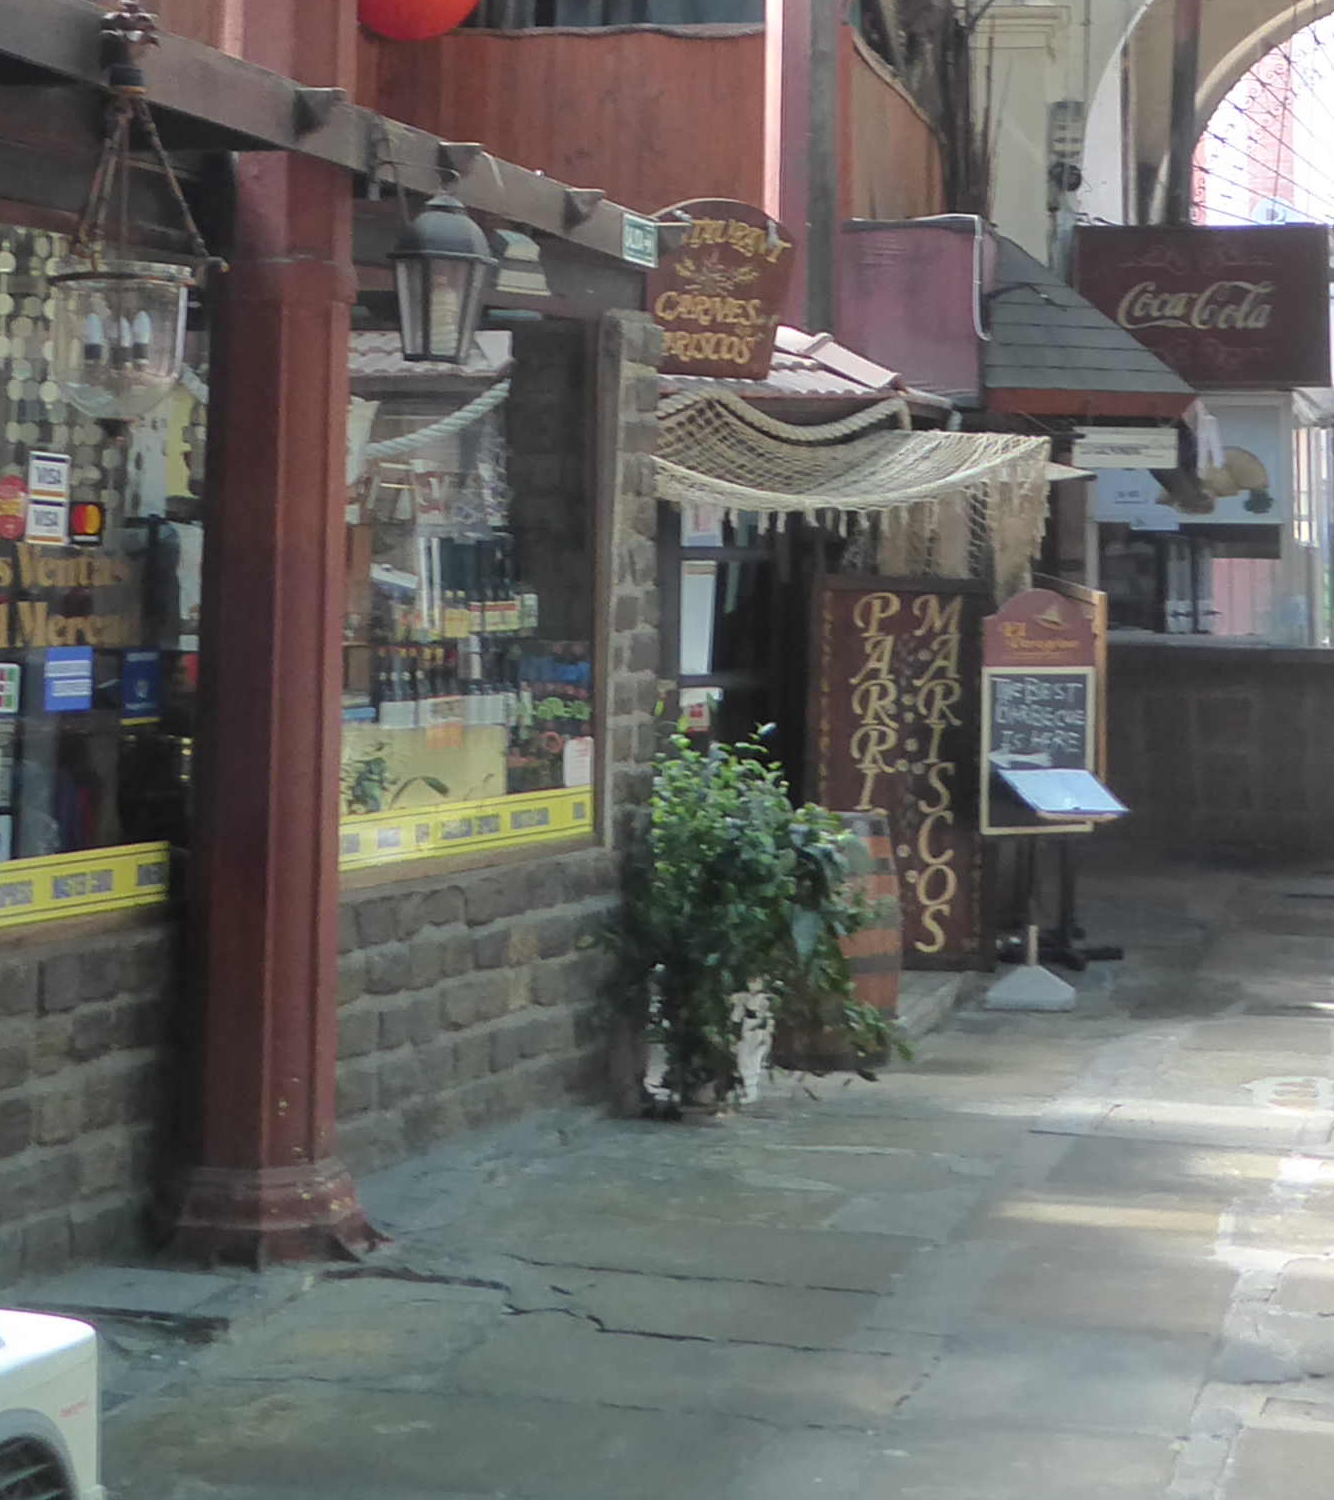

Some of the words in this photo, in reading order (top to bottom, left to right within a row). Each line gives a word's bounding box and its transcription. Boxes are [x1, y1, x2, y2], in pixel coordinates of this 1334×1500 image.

[655, 291, 762, 326] CARNES
[1118, 281, 1275, 329] Coca-Cola
[848, 592, 901, 815] PARRI
[912, 593, 964, 953] MARISCOS
